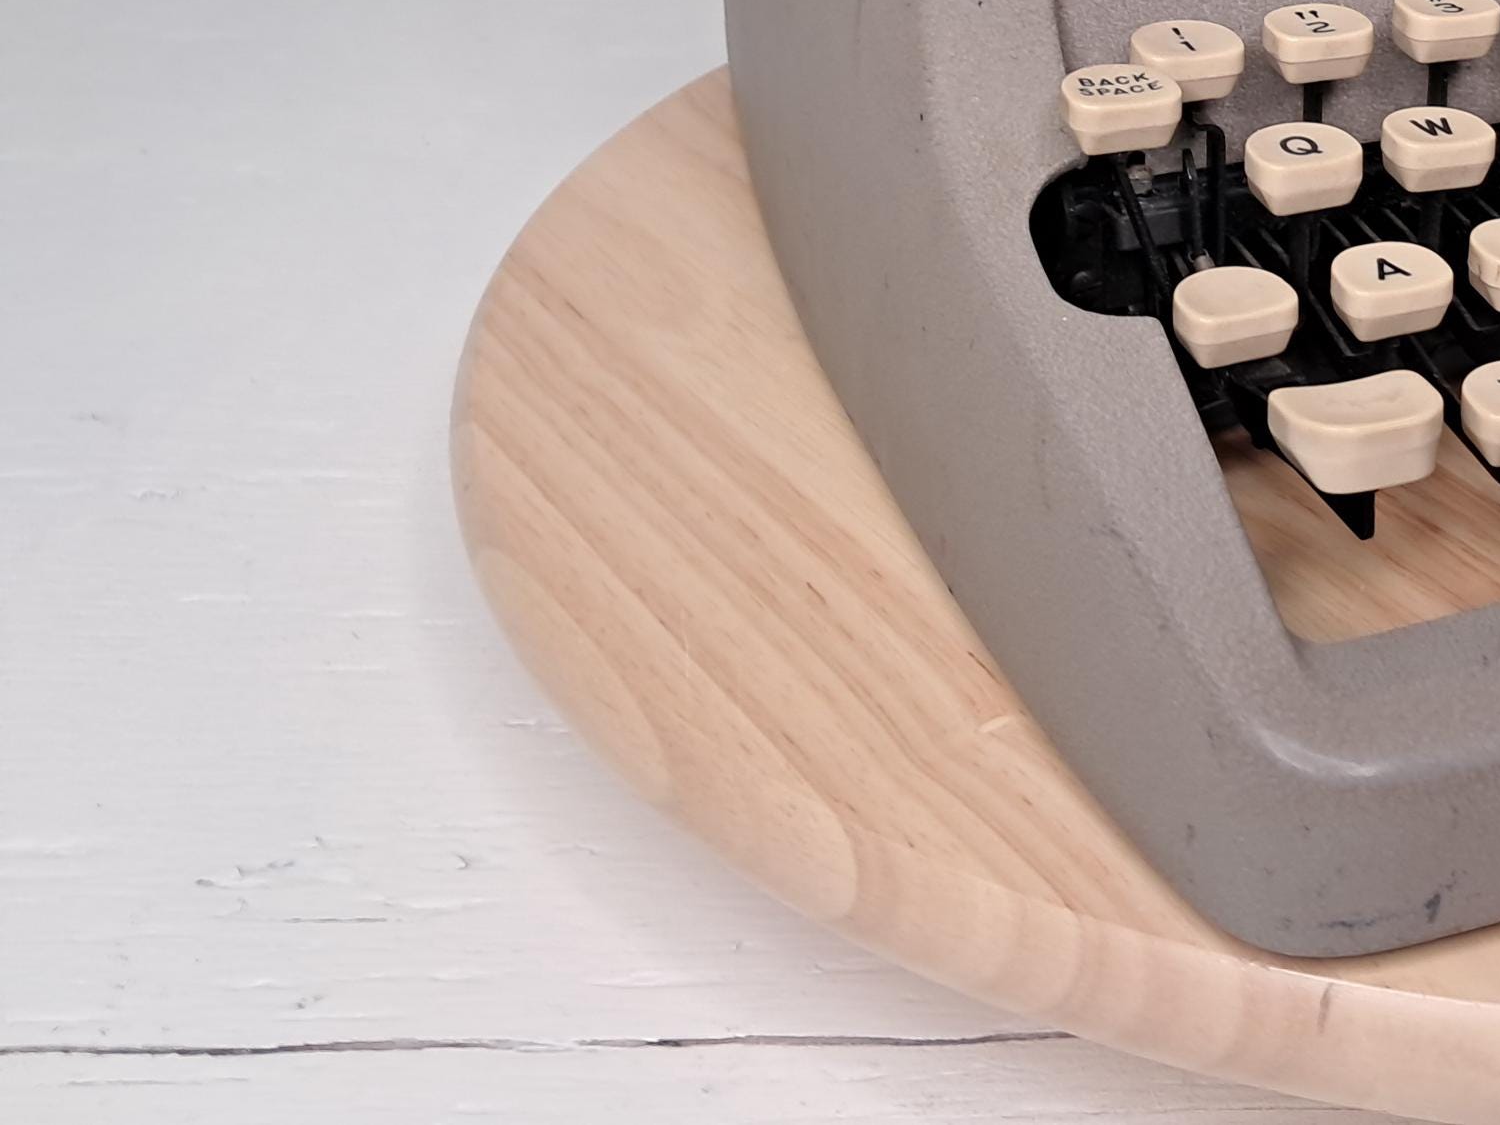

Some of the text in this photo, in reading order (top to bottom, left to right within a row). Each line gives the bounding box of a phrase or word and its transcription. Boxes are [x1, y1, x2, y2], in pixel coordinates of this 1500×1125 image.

[1078, 73, 1149, 87] BACK
[1078, 80, 1163, 96] SPACE
[1410, 118, 1453, 136] W
[1280, 136, 1323, 155] Q
[1377, 258, 1411, 280] A
